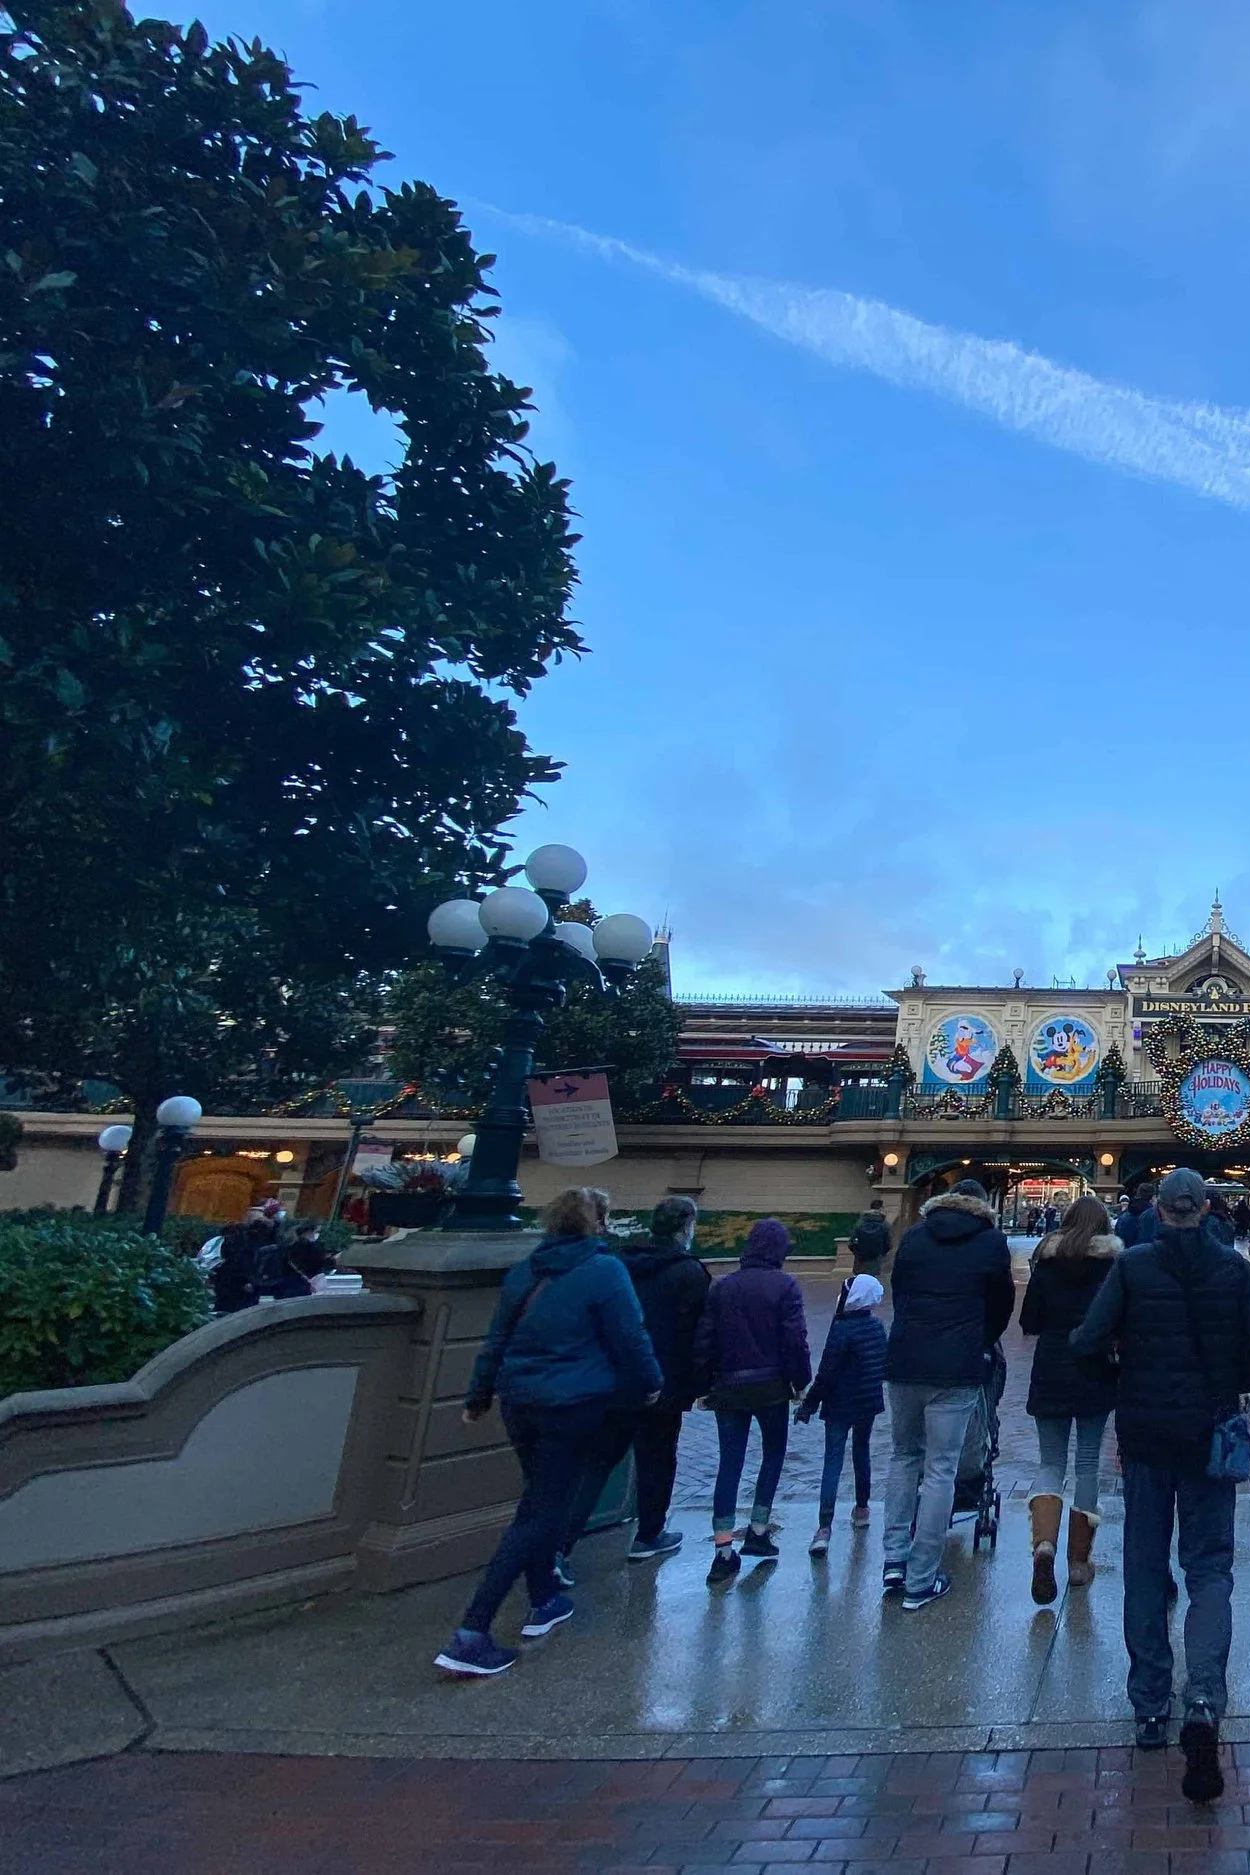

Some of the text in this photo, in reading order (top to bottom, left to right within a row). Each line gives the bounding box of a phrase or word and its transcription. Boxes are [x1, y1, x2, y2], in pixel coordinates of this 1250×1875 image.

[1142, 1001, 1240, 1013] DISNEYLAND
[1202, 1060, 1233, 1076] HAPPY
[1188, 1075, 1241, 1098] HOLIDAYS
